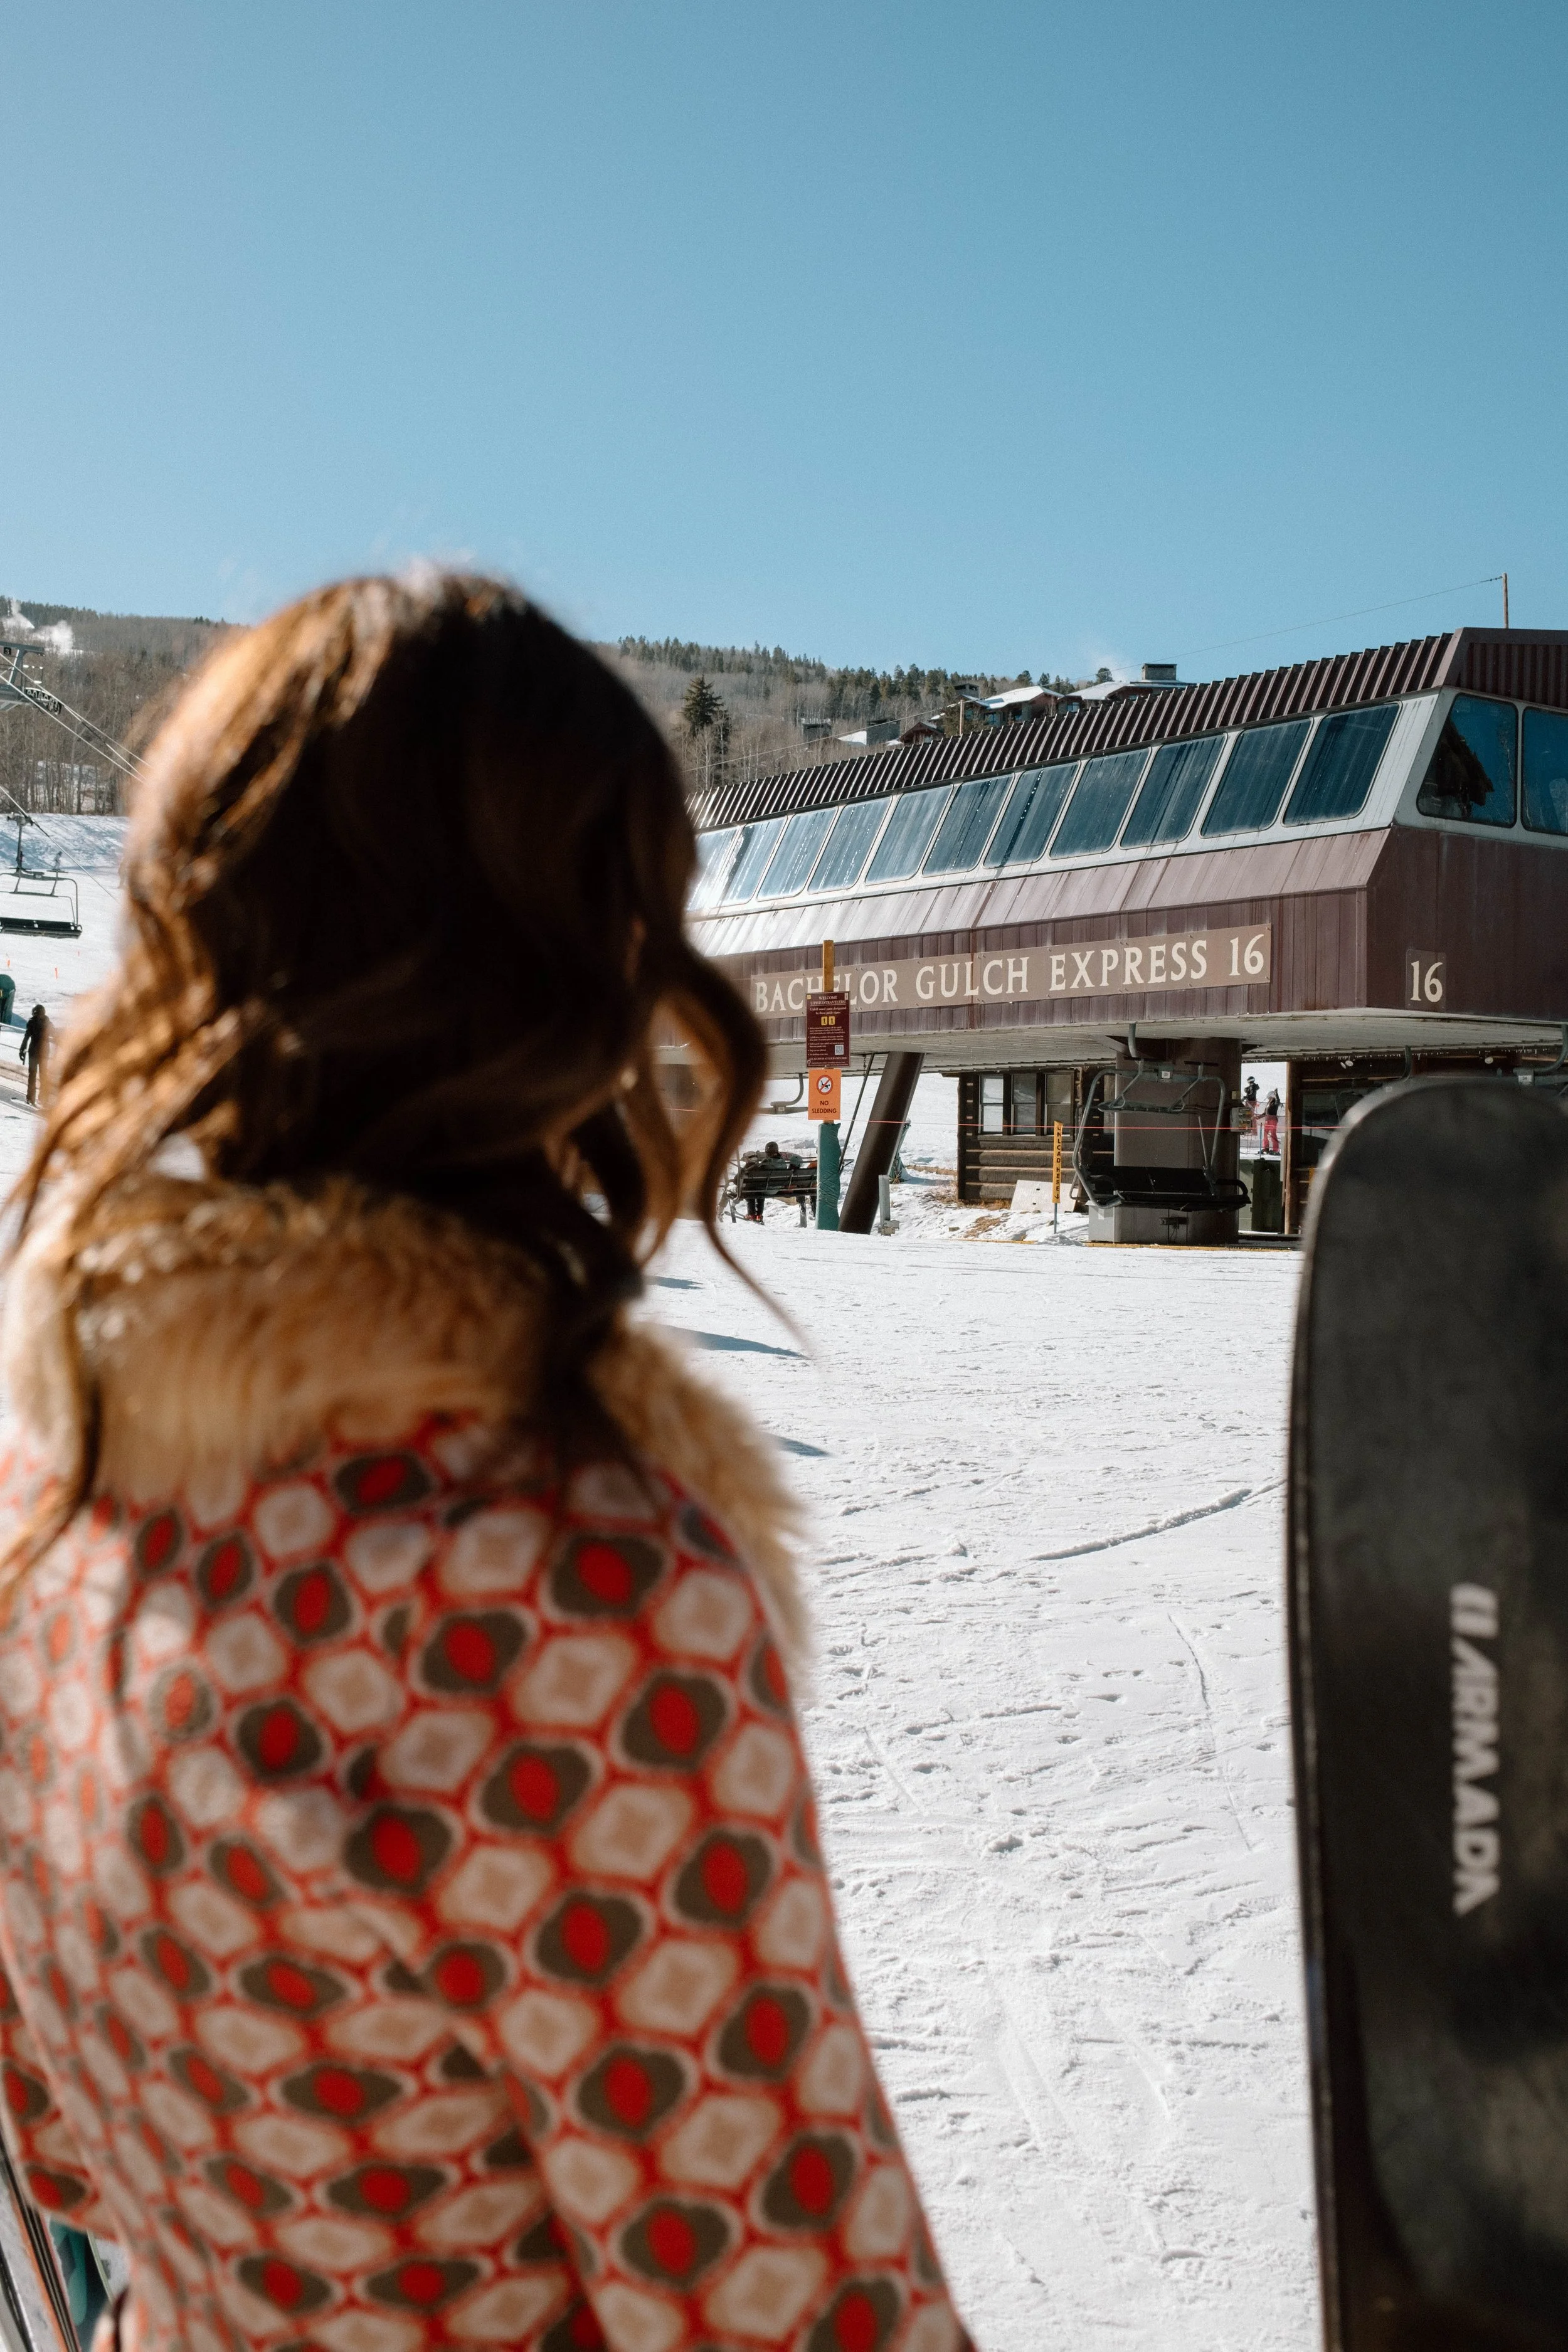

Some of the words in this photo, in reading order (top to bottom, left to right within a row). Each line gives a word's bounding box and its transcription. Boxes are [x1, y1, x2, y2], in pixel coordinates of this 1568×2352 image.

[916, 956, 1030, 1000] GULCH
[1049, 940, 1207, 991] EXPRESS
[1229, 934, 1264, 976] 16
[1410, 960, 1443, 1002] 16
[1451, 1634, 1500, 1917] ARMADA
